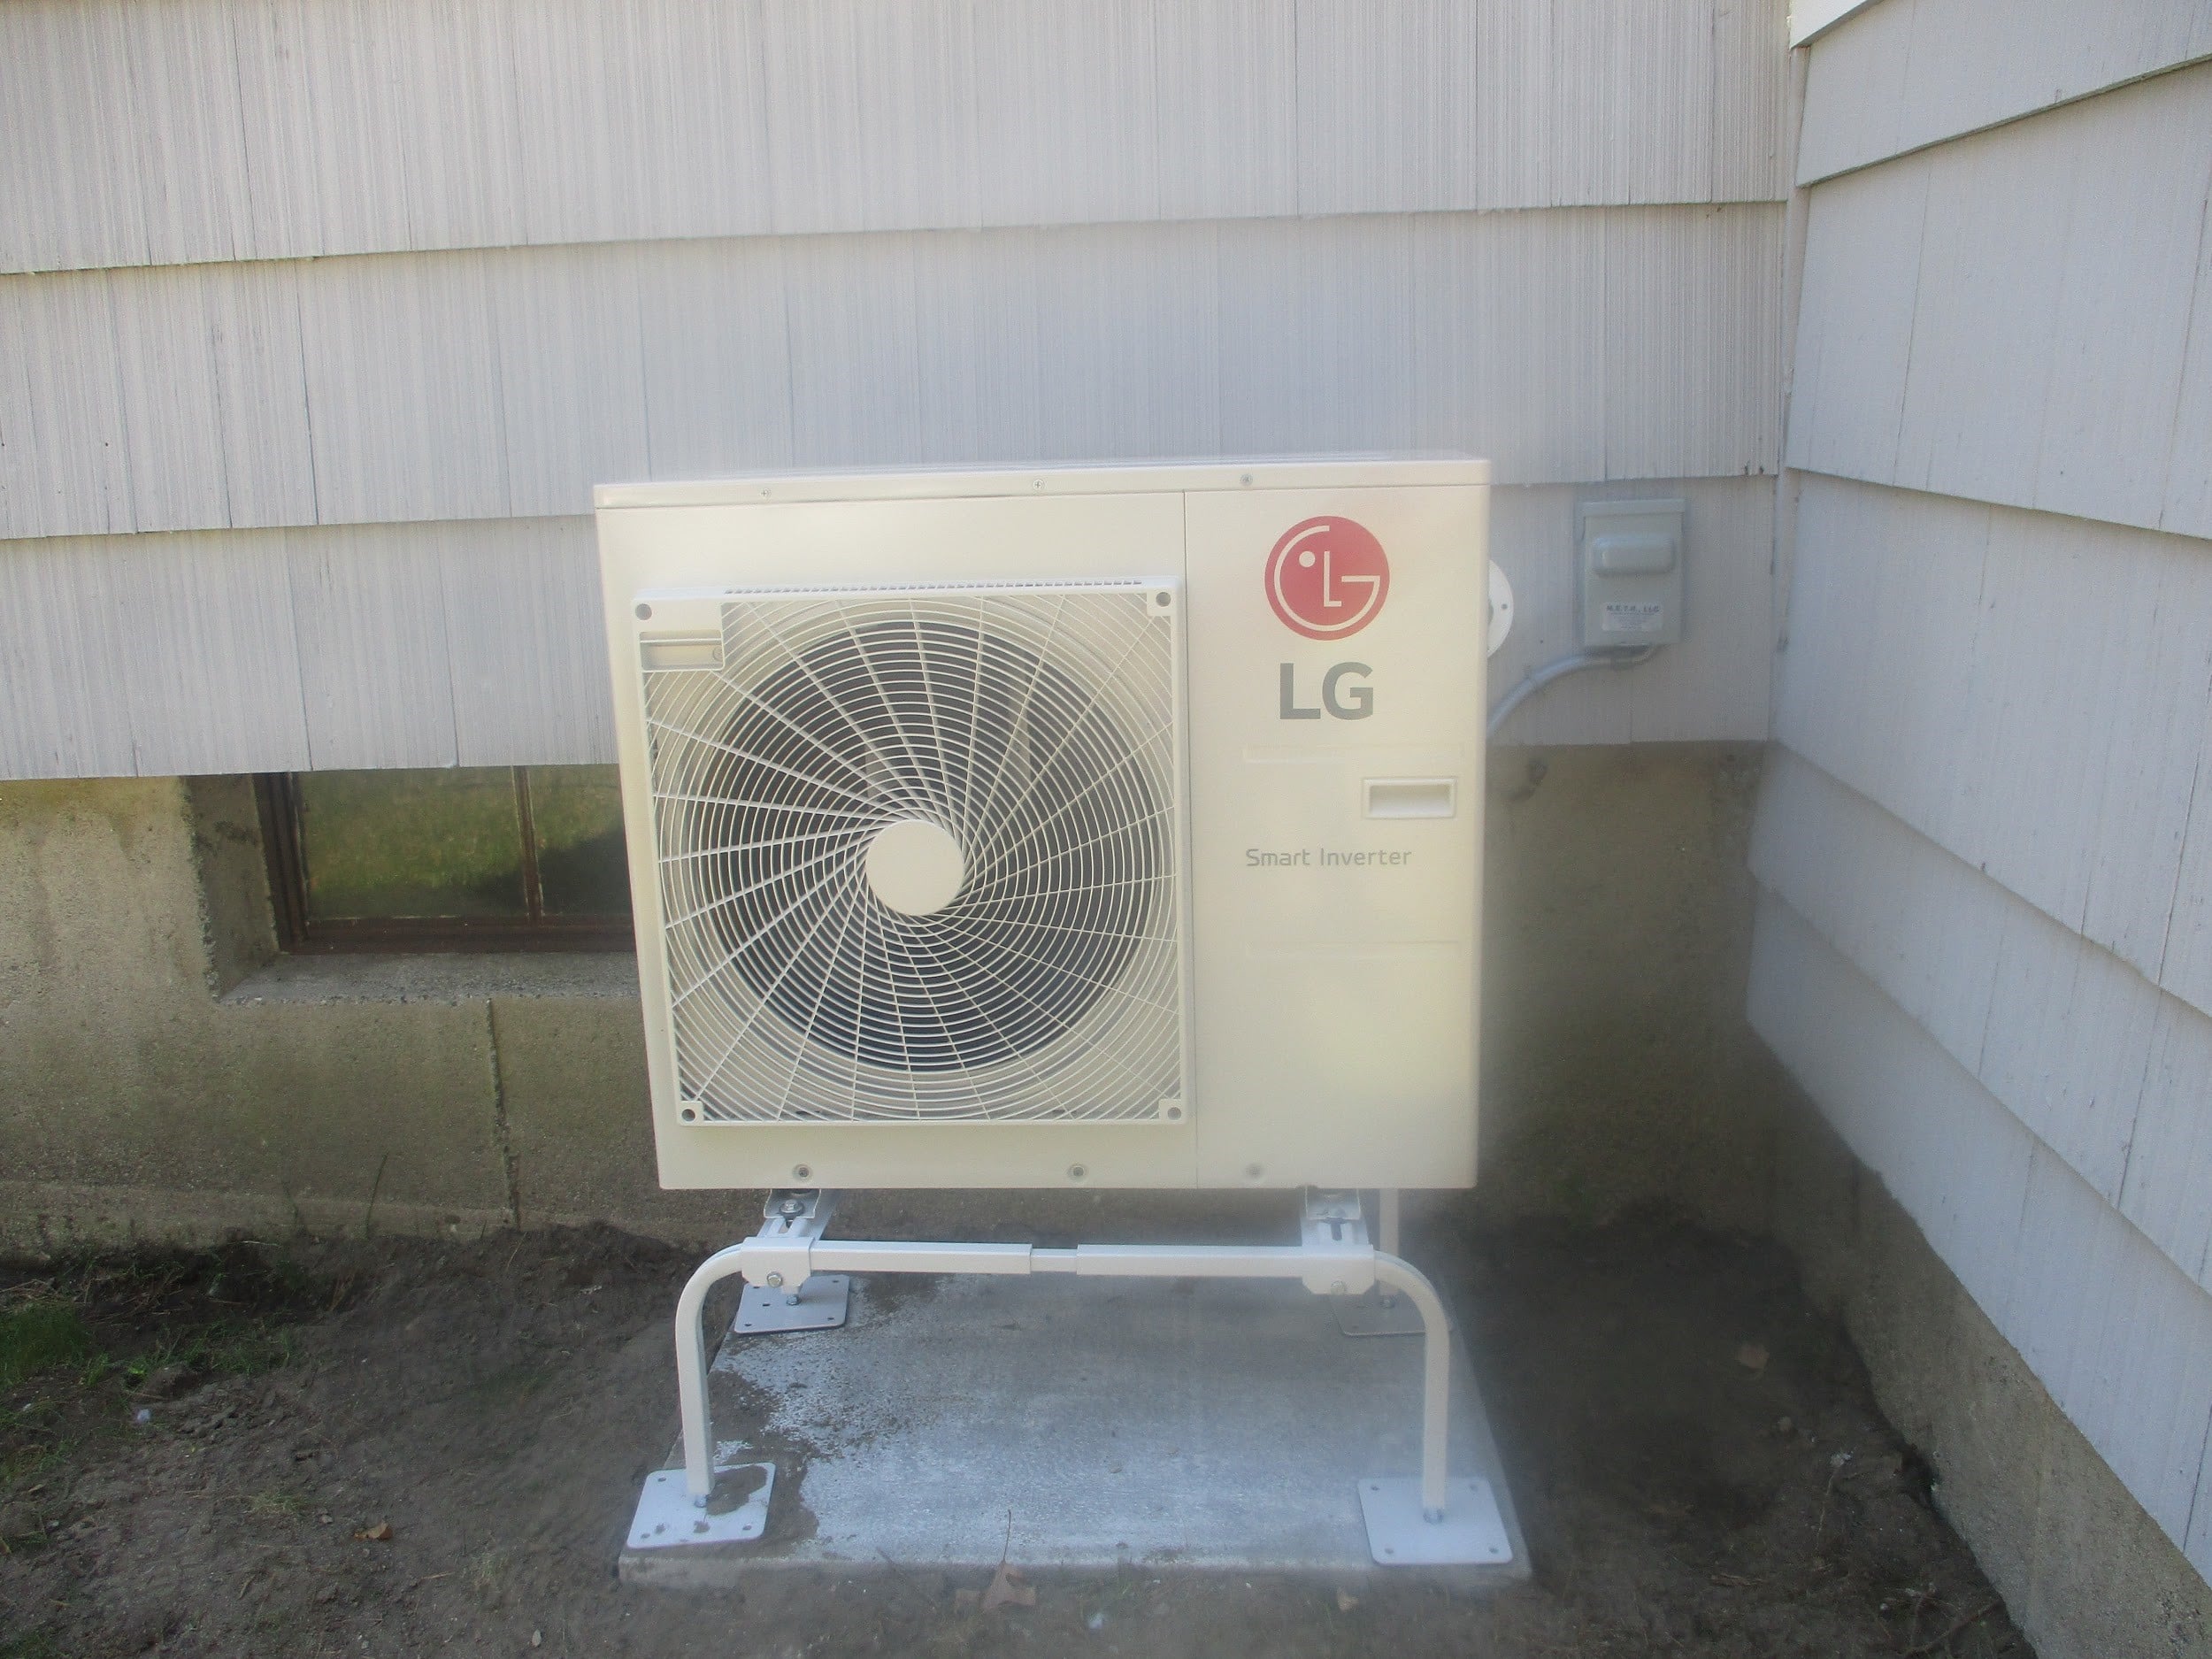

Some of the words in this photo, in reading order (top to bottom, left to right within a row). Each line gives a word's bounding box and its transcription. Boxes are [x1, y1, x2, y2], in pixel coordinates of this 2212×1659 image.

[1279, 661, 1374, 721] LG
[1246, 849, 1310, 866] Smart
[1320, 848, 1412, 866] Inverter
